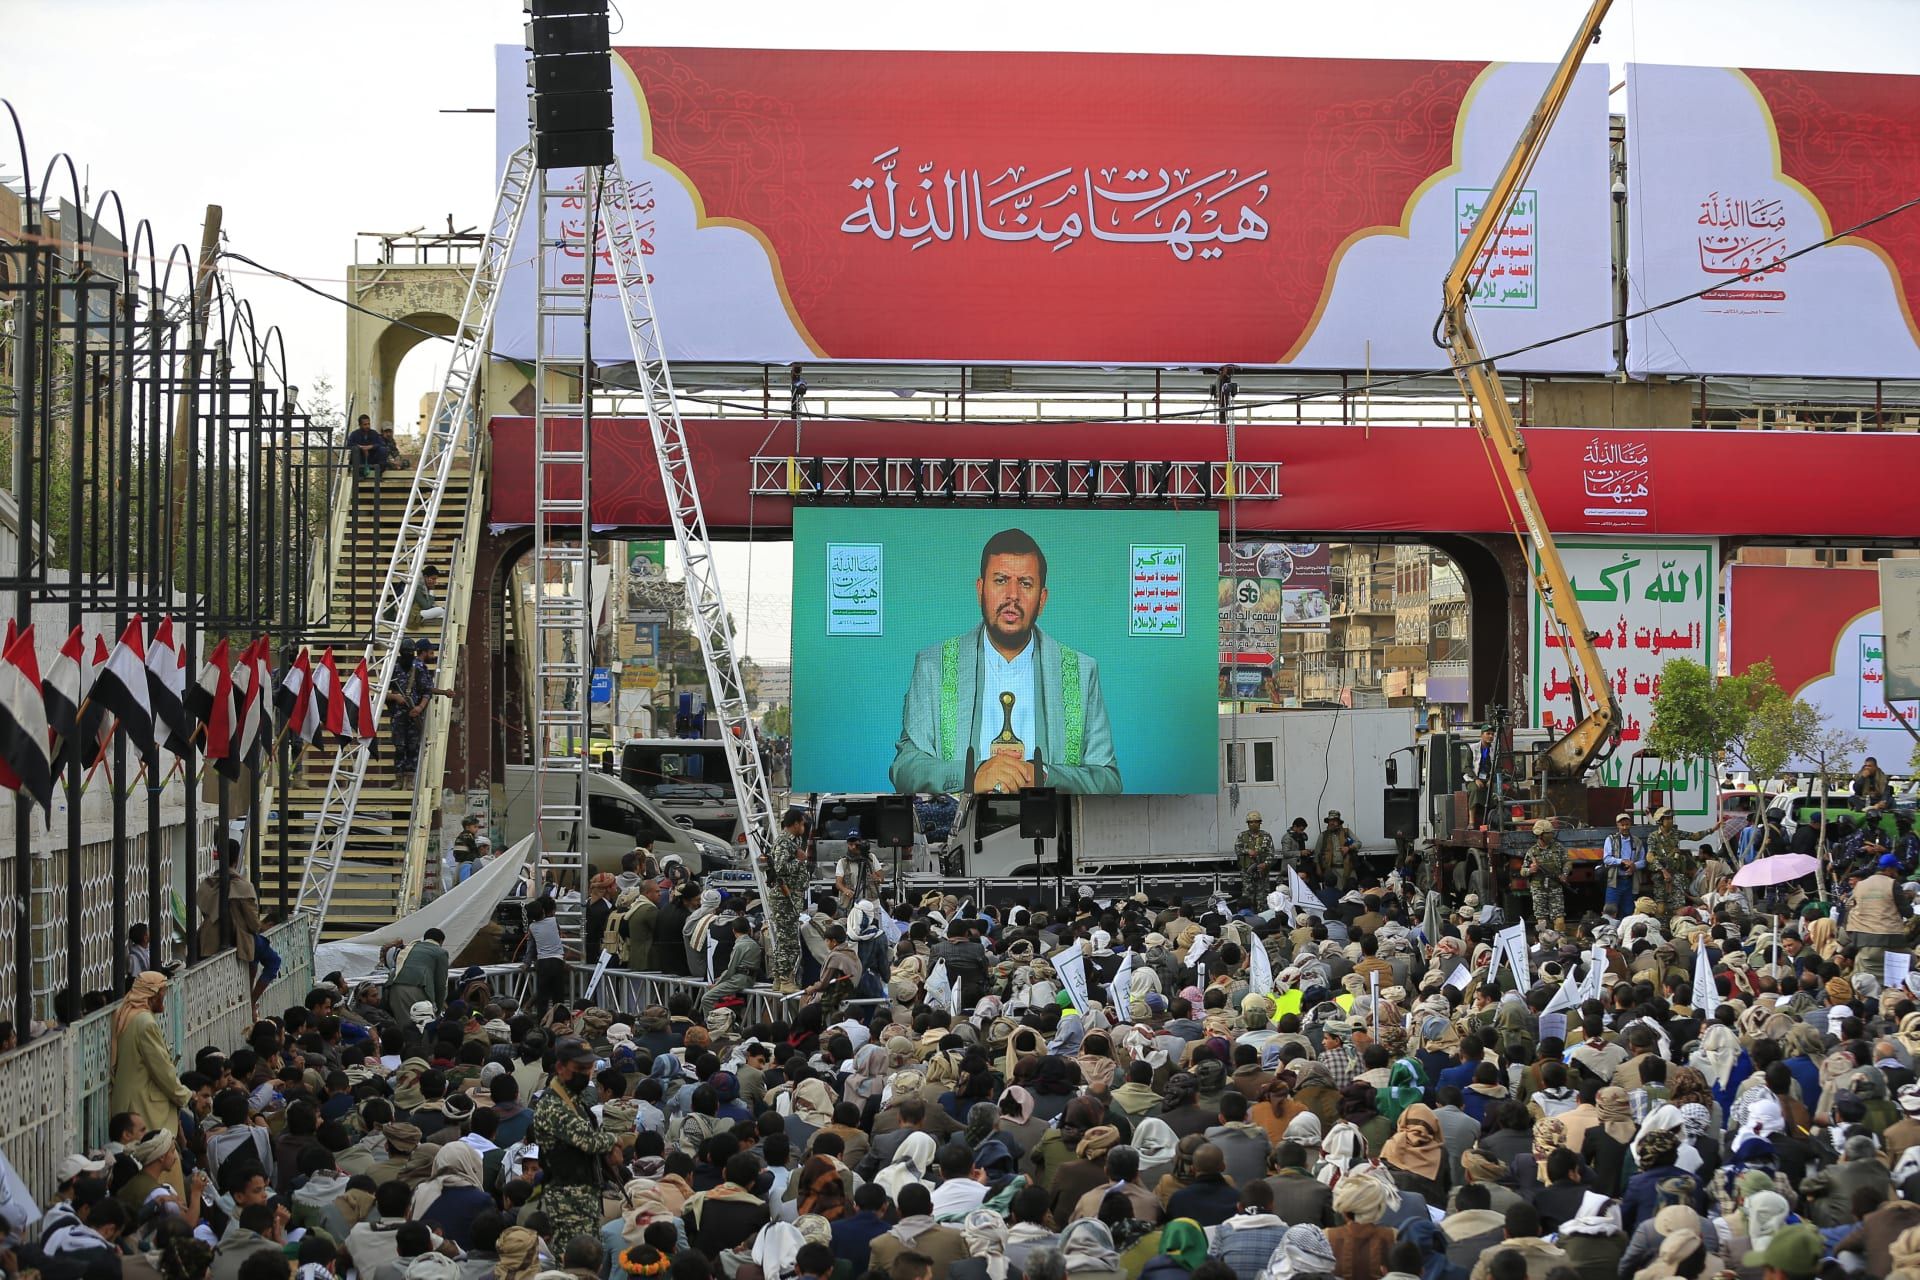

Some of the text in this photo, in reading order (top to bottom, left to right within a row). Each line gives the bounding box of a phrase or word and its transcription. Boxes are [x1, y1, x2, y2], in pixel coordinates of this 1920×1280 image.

[1239, 587, 1258, 604] SG
[1644, 559, 1704, 604] الله
[1634, 620, 1701, 656] الموت
